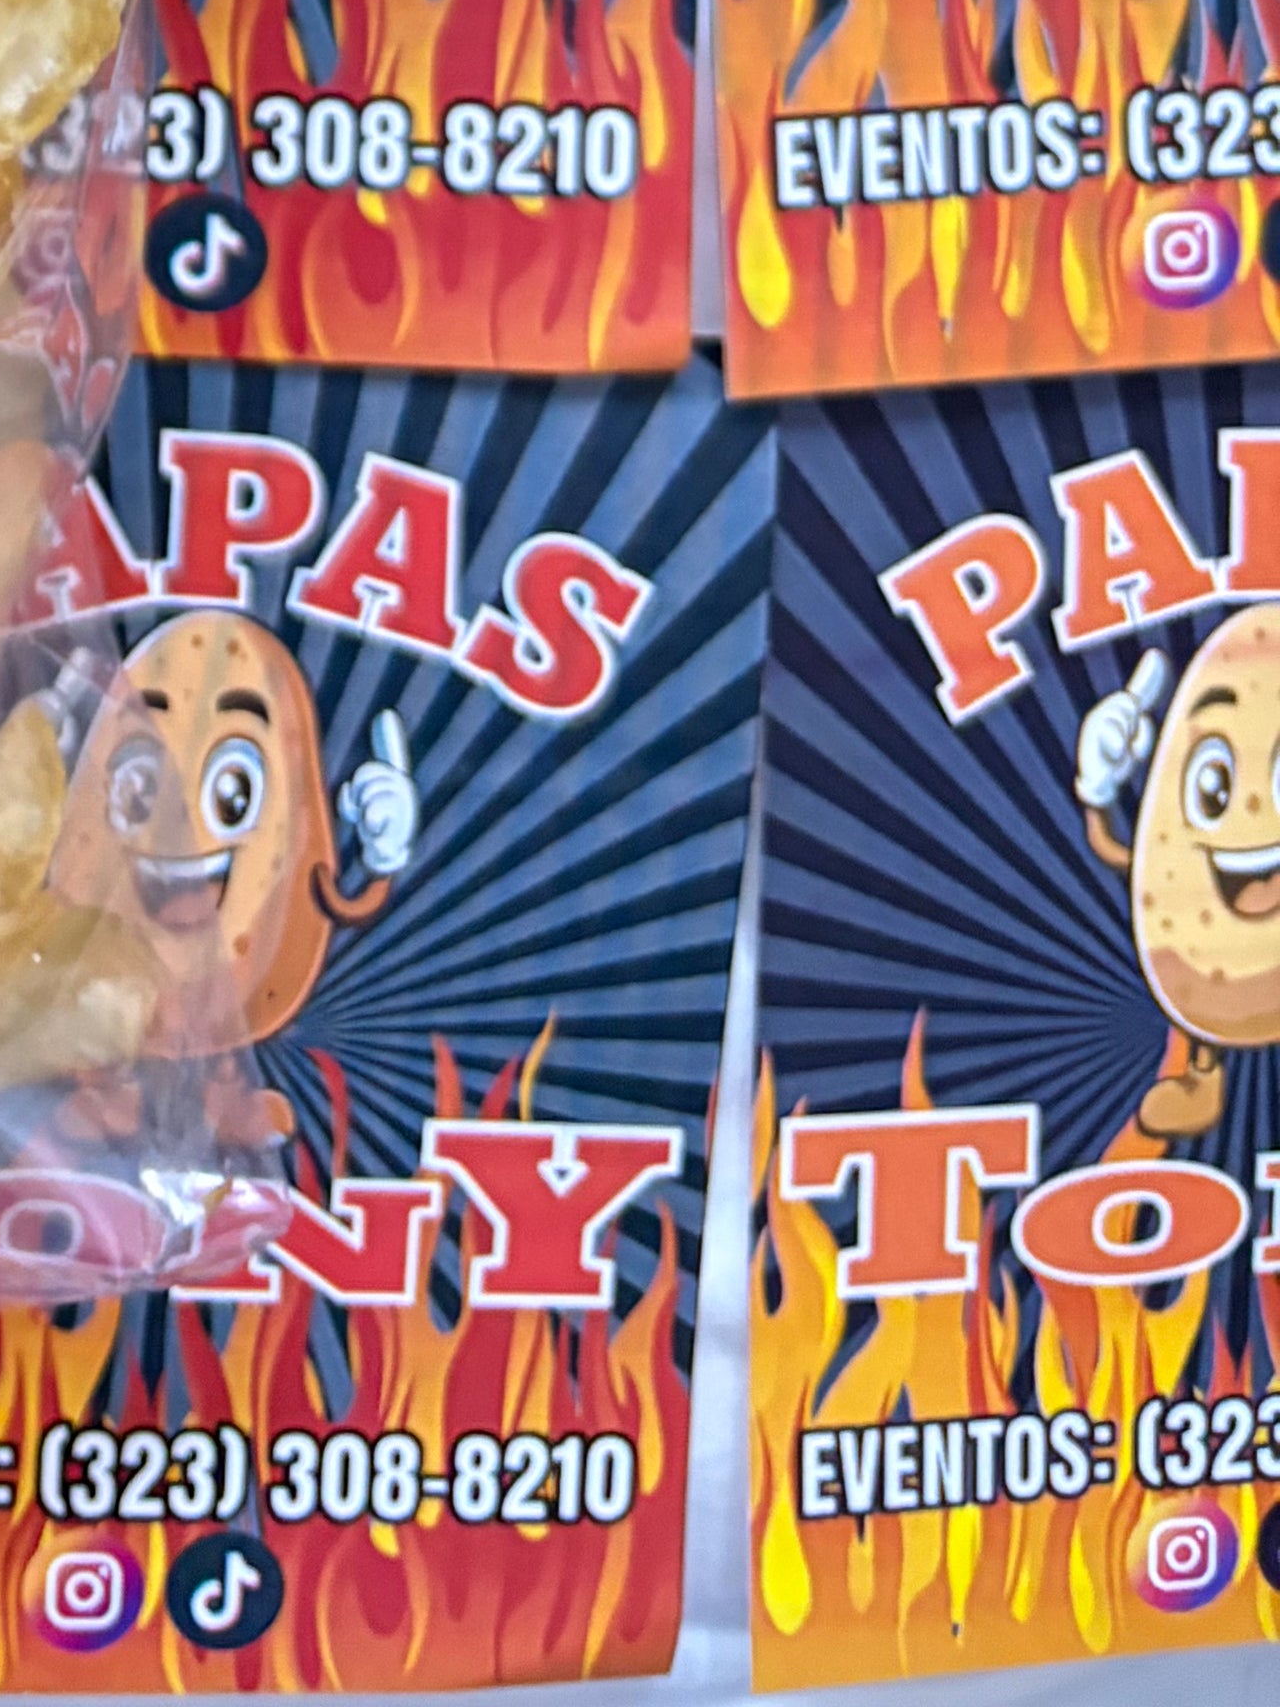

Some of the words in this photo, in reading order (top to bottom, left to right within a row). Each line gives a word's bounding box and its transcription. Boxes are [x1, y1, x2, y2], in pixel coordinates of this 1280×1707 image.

[250, 92, 638, 199] 308-8210
[774, 108, 1106, 209] EVENTOS:
[778, 1102, 1280, 1299] TO
[38, 1425, 243, 1521] (323)
[270, 1432, 635, 1523] 308-8210
[802, 1422, 1114, 1517] EVENTOS:
